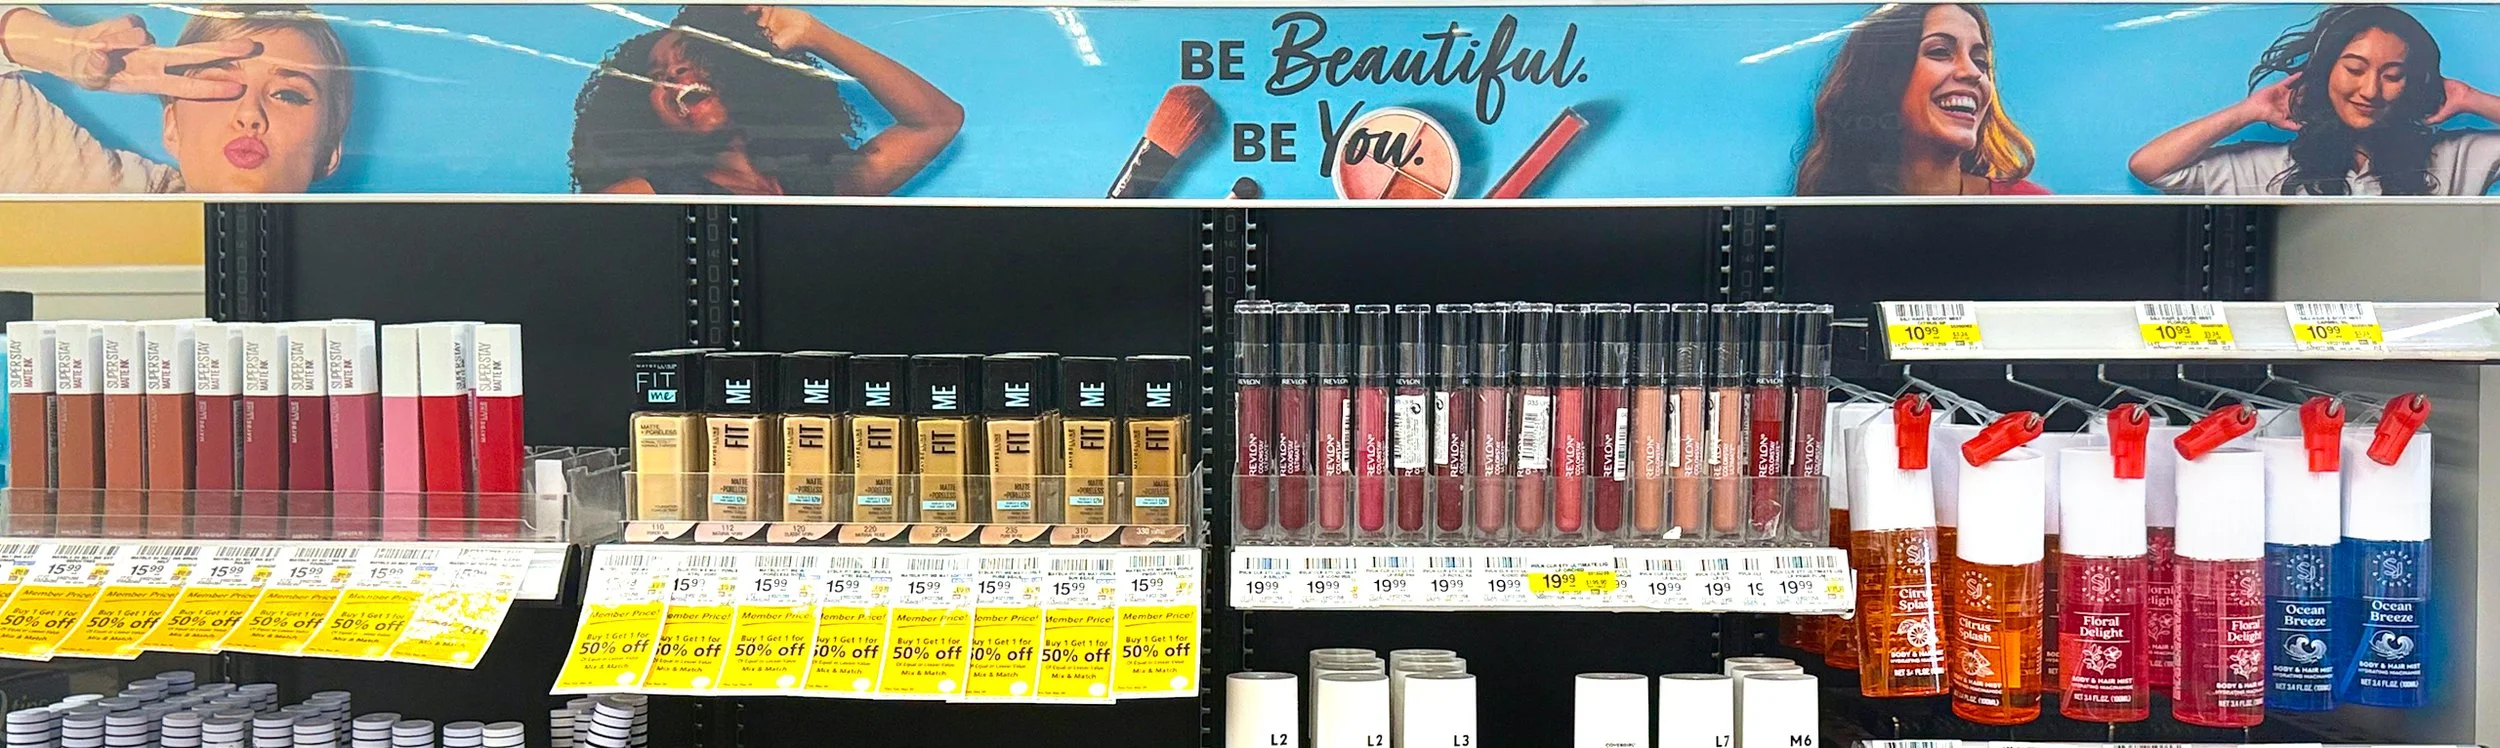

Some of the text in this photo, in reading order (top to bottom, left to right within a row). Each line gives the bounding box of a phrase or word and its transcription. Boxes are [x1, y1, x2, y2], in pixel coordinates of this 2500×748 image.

[1181, 12, 1588, 124] BE Beautiful.
[1233, 100, 1425, 178] BE You.
[636, 372, 676, 393] FIT
[650, 390, 675, 401] me
[726, 379, 751, 404] ME
[804, 378, 829, 404] ME
[866, 381, 891, 406] ME
[932, 385, 957, 410] ME
[1005, 382, 1030, 407] ME
[1080, 382, 1105, 407] ME
[1146, 382, 1171, 407] ME
[725, 424, 749, 448] FIT
[799, 424, 824, 448] FIT
[868, 425, 892, 449] FIT
[932, 430, 956, 454] FIT
[1006, 430, 1030, 454] FIT
[1081, 426, 1104, 450] FIT
[1146, 427, 1169, 451] FIT
[2286, 604, 2326, 615] Ocean
[2372, 600, 2412, 612] Ocean
[1, 615, 75, 628] 50% off
[86, 617, 162, 628] 50% off
[250, 616, 324, 628] 50% off
[1959, 616, 1992, 632] Citrus
[2083, 616, 2120, 626] Floral
[2284, 616, 2326, 626] Breeze
[2370, 612, 2414, 622] Breeze
[2232, 620, 2261, 630] Floral
[1958, 628, 1992, 643] Splash
[2080, 627, 2124, 640] Delight
[2228, 631, 2262, 644] Delight
[579, 640, 650, 654] 50% off
[735, 643, 806, 656] 50% off
[893, 646, 963, 660] 50% off
[1123, 643, 1190, 658] 50% off
[1042, 648, 1111, 662] 50% off
[2359, 661, 2378, 669] BODY
[1270, 734, 1288, 746] L2
[1367, 735, 1383, 747] L2
[1454, 734, 1470, 747] L3
[1716, 735, 1730, 748] L7
[1790, 734, 1812, 747] M6
